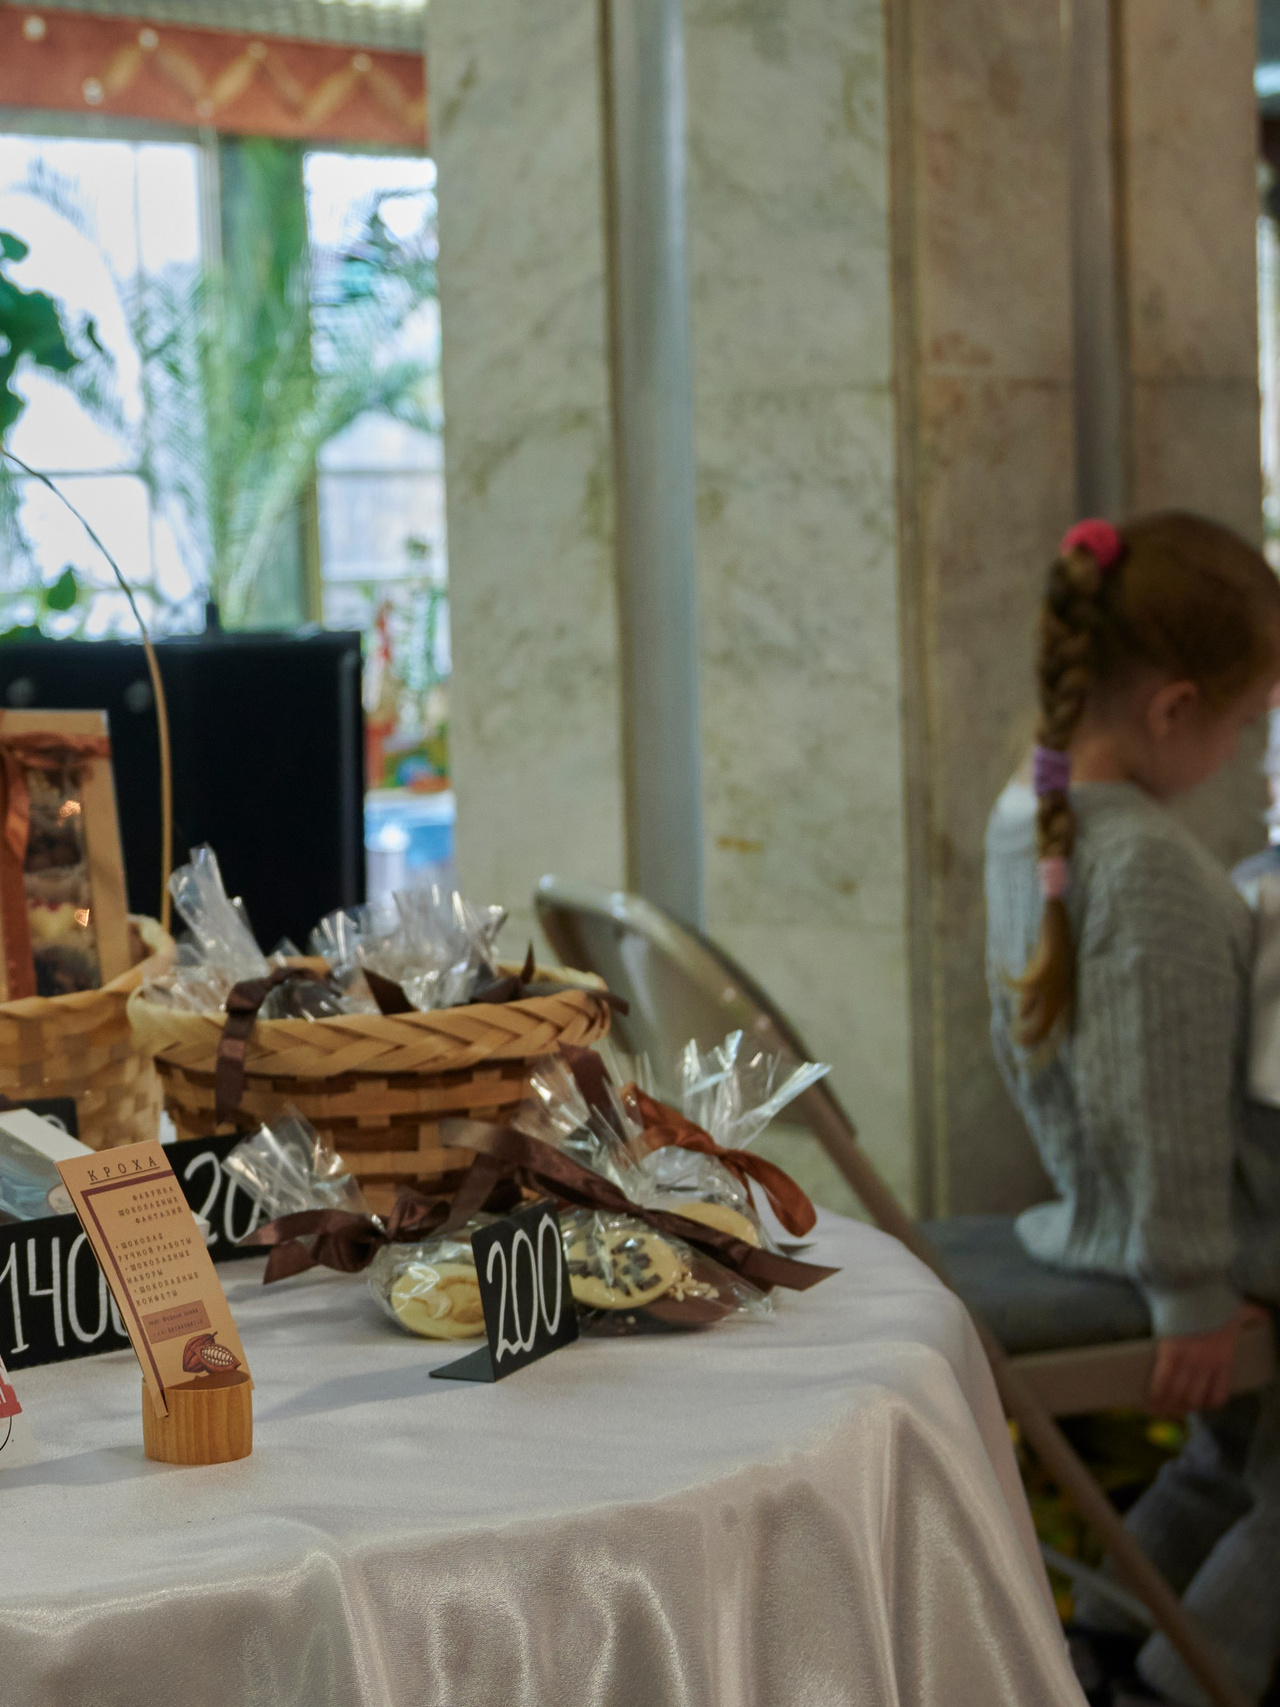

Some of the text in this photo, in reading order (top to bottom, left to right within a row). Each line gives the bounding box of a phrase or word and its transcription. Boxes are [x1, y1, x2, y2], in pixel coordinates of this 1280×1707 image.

[87, 1156, 157, 1181] КРОХА
[132, 1186, 174, 1201] ФАБРИКА
[118, 1196, 179, 1216] ШОКОЛАДНЫХ
[135, 1206, 184, 1224] ФАНТАЗИЙ
[118, 1237, 191, 1262] РУЧНОЙ РАБОТЫ
[121, 1232, 163, 1249] ШОКОЛАД
[130, 1249, 190, 1271] ШОКОЛАДНЫЕ
[126, 1268, 163, 1284] НАБОРЫ
[139, 1271, 199, 1294] ШОКОЛАДНЫЕ
[486, 1213, 562, 1362] 200
[136, 1289, 178, 1307] КОНФЕТЫ
